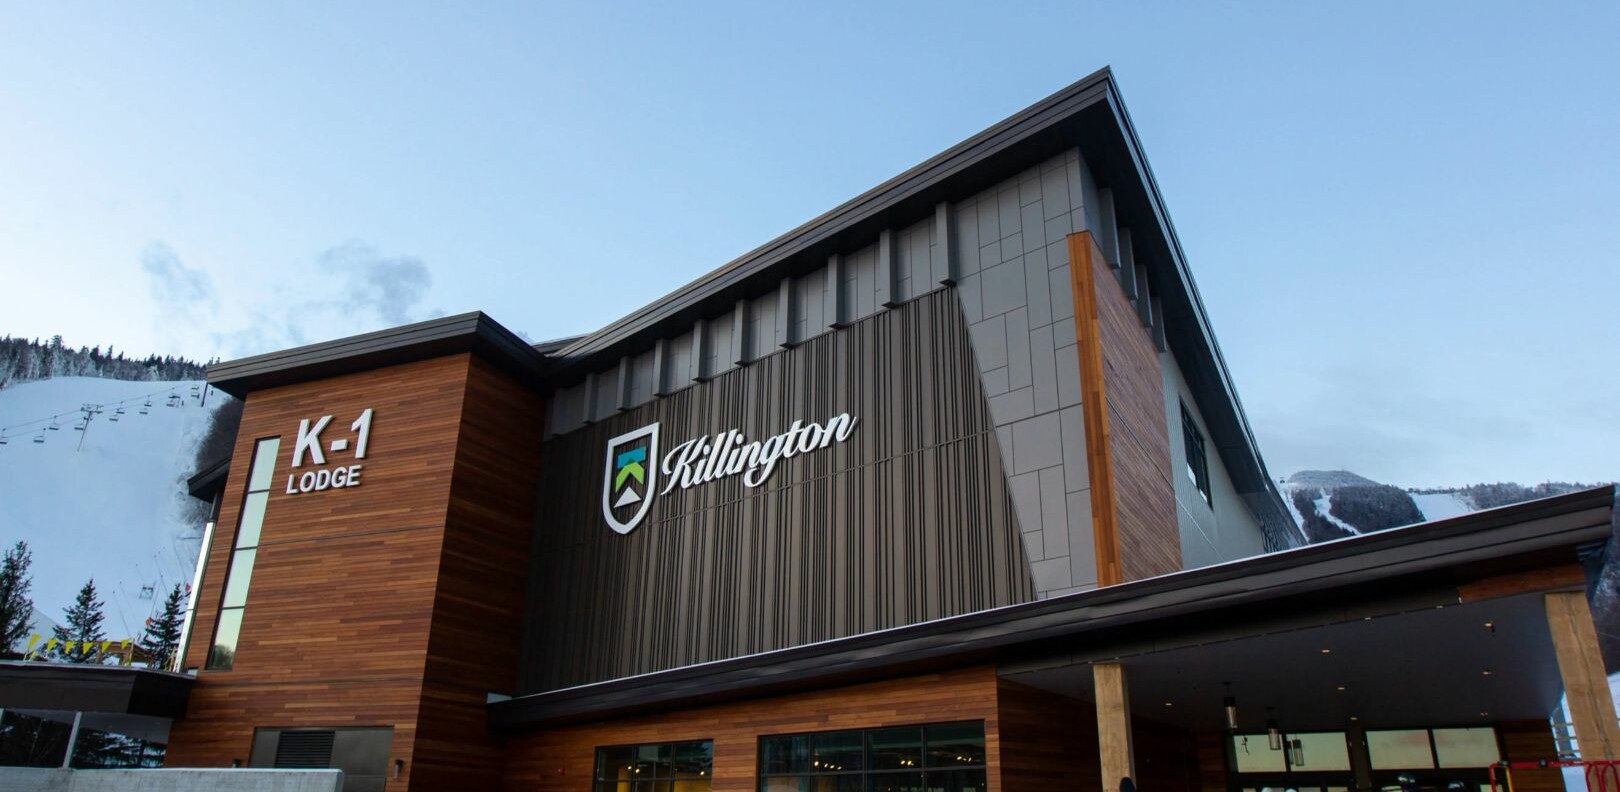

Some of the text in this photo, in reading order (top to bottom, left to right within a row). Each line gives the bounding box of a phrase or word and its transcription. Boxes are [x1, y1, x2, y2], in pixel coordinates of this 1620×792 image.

[291, 408, 373, 468] K-1
[660, 412, 857, 496] Killington
[286, 464, 363, 495] LODGE
